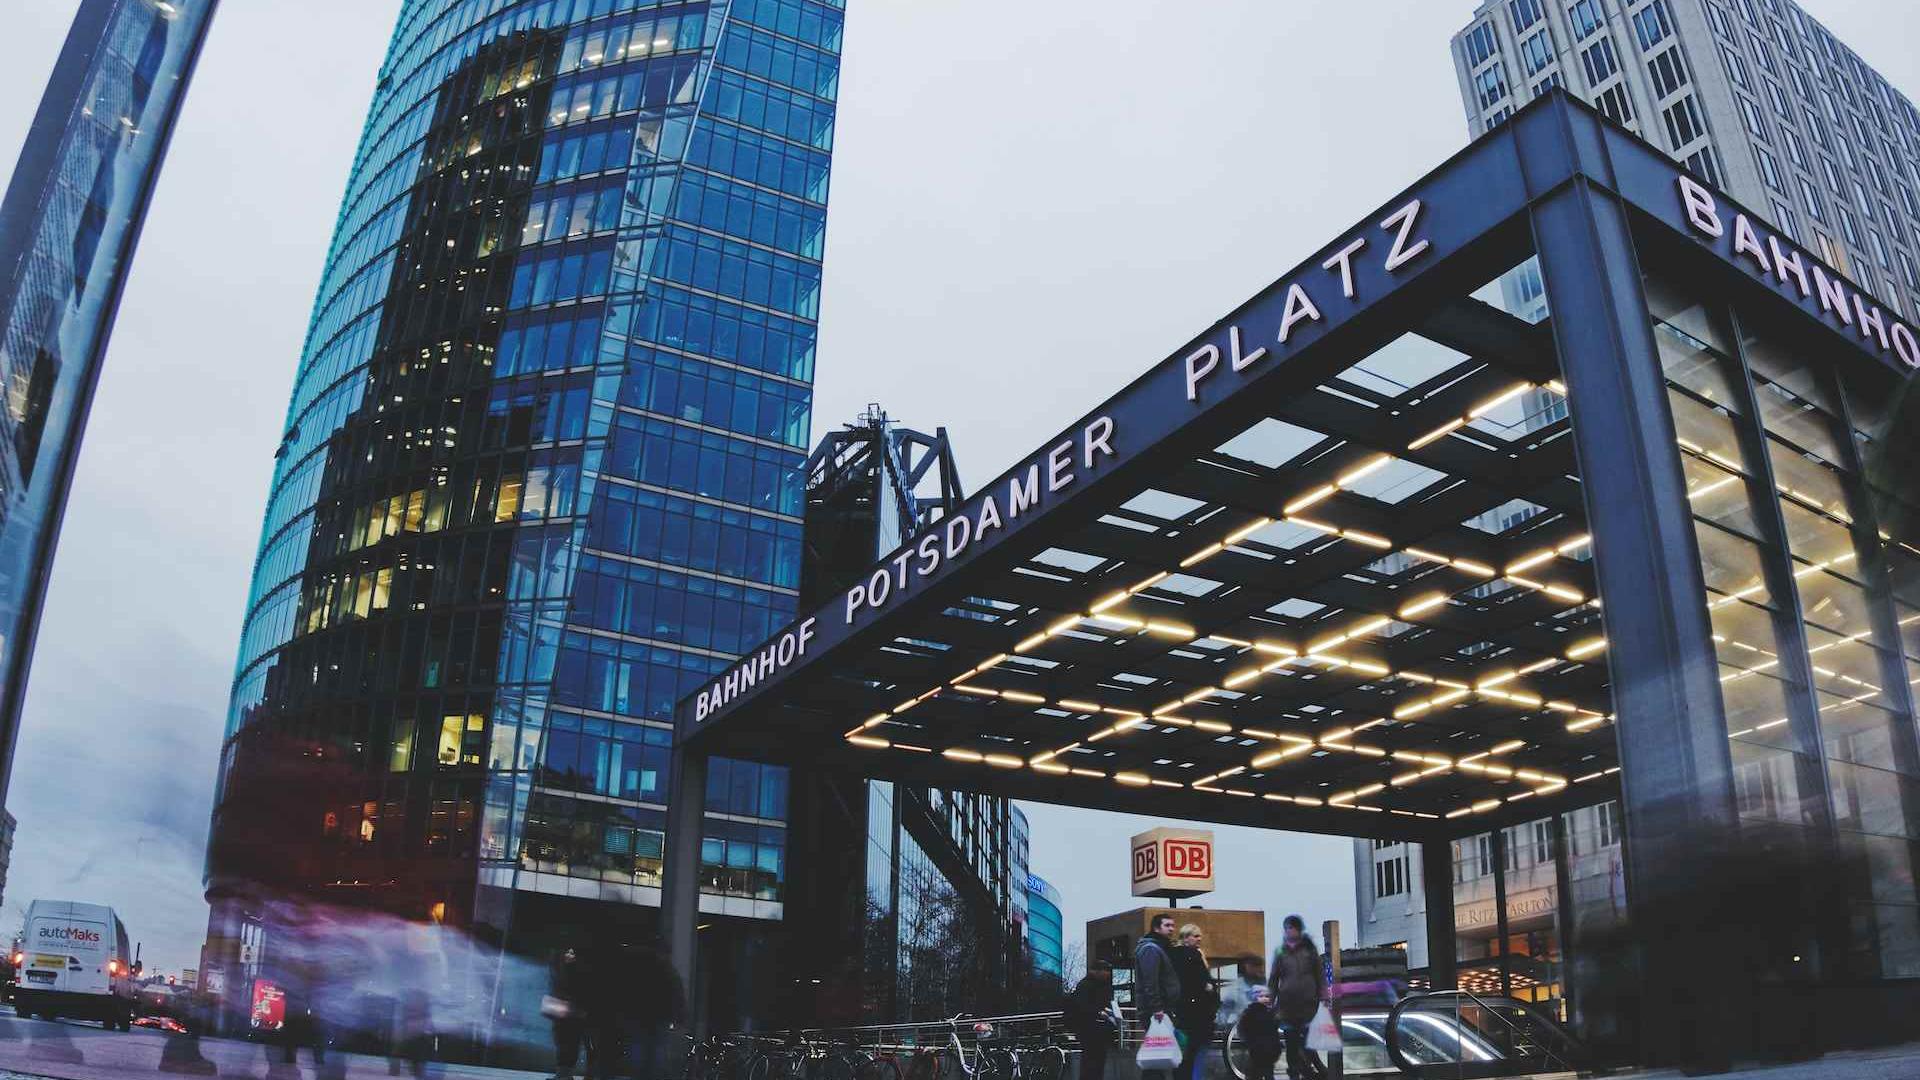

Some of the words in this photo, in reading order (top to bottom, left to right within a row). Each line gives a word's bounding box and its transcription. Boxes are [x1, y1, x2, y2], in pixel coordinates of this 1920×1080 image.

[694, 616, 817, 723] BAHNHOF
[845, 415, 1116, 625] POTSDAMER
[1185, 198, 1431, 401] PLATZ
[1135, 847, 1156, 878] DB
[1169, 845, 1206, 872] DB
[39, 926, 101, 942] autoMaks
